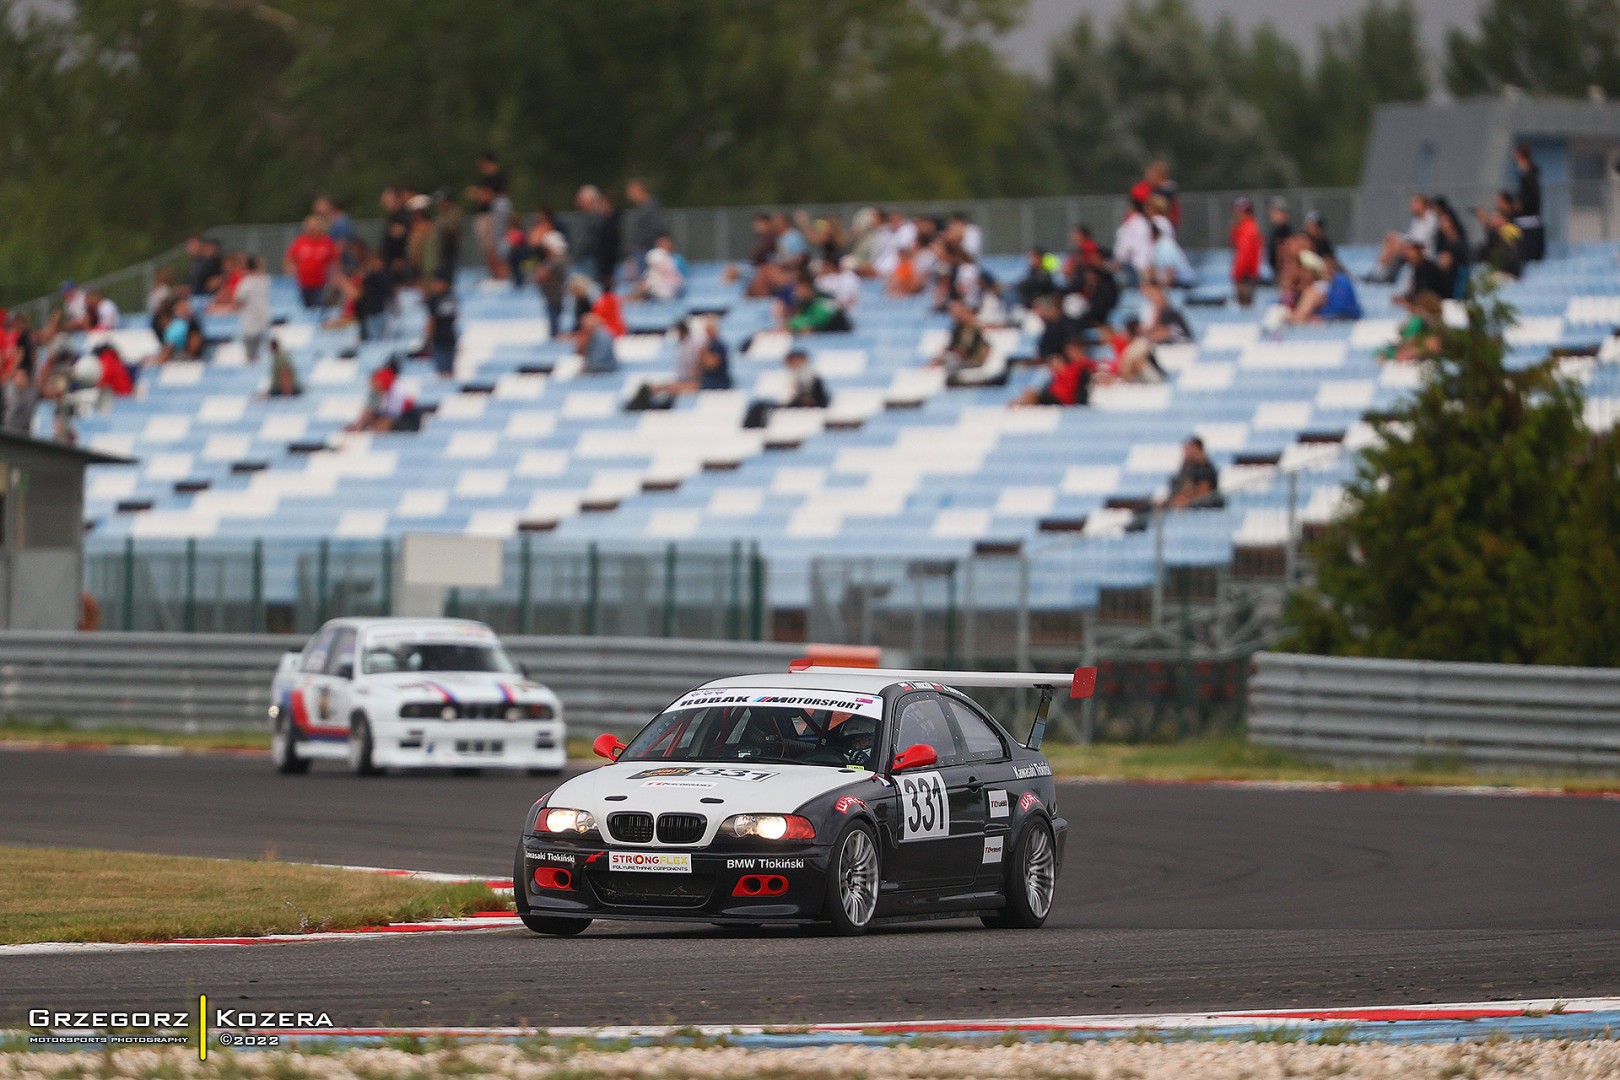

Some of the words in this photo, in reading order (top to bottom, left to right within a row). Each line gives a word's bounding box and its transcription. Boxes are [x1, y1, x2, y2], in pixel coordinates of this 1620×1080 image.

[764, 696, 864, 711] MOTORSPORT
[904, 776, 944, 833] 331
[612, 854, 688, 865] STRONGFLEX
[726, 859, 755, 869] BMW
[758, 859, 804, 869] Tłokiński
